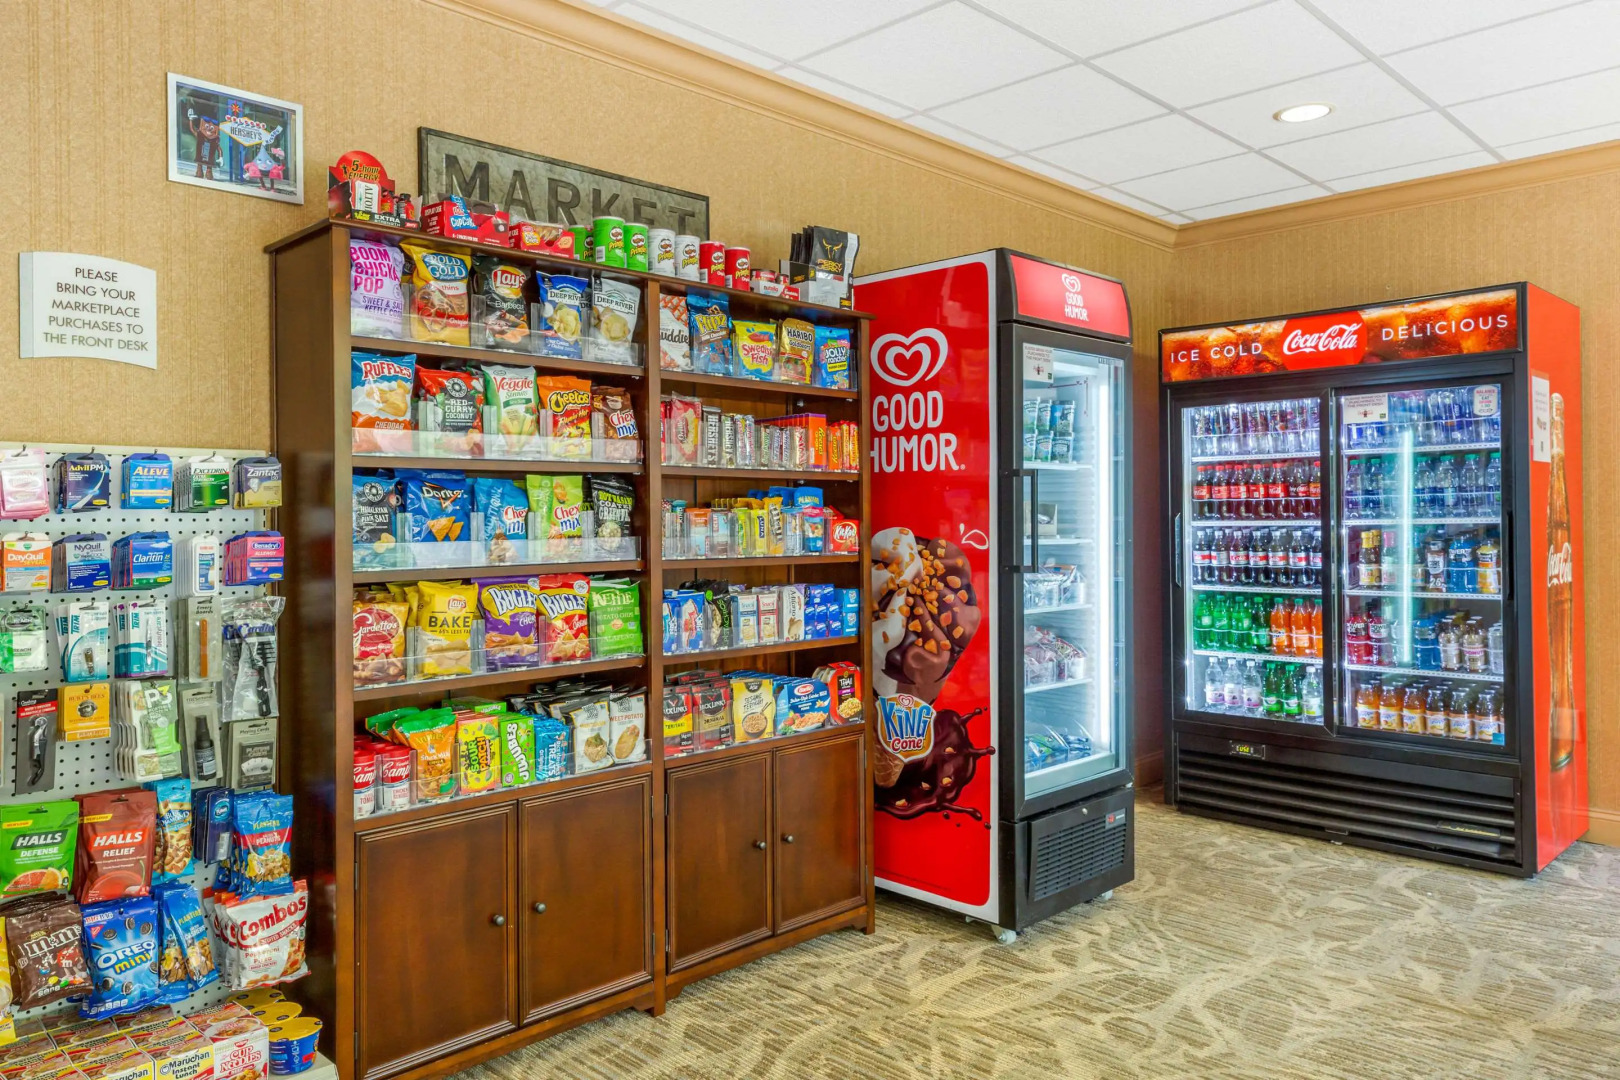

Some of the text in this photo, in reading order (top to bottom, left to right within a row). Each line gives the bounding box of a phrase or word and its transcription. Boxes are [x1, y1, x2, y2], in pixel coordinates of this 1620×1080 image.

[230, 126, 262, 141] HERSHEY'S
[365, 185, 374, 212] ALTOI
[444, 153, 695, 235] MARKET
[374, 214, 400, 224] EXTRA
[350, 246, 391, 263] BOOM
[75, 267, 118, 282] PLEASE
[427, 265, 465, 278] GOLD
[496, 271, 526, 288] Lay's
[56, 282, 136, 301] BRING YOUR
[353, 274, 384, 294] POP
[362, 295, 383, 306] SWEET
[549, 290, 565, 299] DEEP
[1065, 291, 1084, 307] GOOD
[52, 299, 140, 318] MARKETPLACE
[364, 305, 387, 315] KETTLE
[596, 297, 634, 312] DEEP RIVER
[1064, 304, 1089, 322] HUMOR
[48, 315, 144, 335] PURCHASES TO
[695, 313, 727, 334] Flipz
[1381, 314, 1509, 341] DELICIOUS
[43, 332, 149, 352] THE FRONT DESK
[787, 327, 813, 343] HARIBO
[1282, 322, 1363, 356] Coca-Cola
[751, 351, 769, 366] Fish
[825, 346, 847, 358] JOLLY
[1170, 342, 1263, 363] ICE COLD
[362, 360, 412, 380] RUFFLES
[493, 376, 533, 393] Veggie
[550, 391, 590, 412] Cheetos
[609, 411, 634, 426] Chex
[872, 390, 944, 432] GOOD
[374, 421, 404, 430] CHEDDAR
[617, 422, 637, 437] mix
[707, 415, 719, 461] HERSHEY'S
[870, 433, 958, 473] HUMOR
[69, 464, 90, 472] Advil
[133, 466, 170, 475] ALEVE
[247, 468, 280, 477] Zantac
[375, 514, 389, 522] SALT
[553, 504, 580, 520] Chex
[507, 519, 526, 534] mi
[560, 518, 581, 532] mix
[757, 515, 765, 538] LUNA
[74, 542, 102, 552] NyQuil
[8, 552, 44, 562] DayQuil
[133, 553, 163, 563] Claritin
[71, 614, 80, 635] TRIM
[131, 612, 140, 629] TRIM
[428, 615, 471, 628] BAKE
[879, 697, 932, 743] KING
[506, 722, 531, 781] JUJUBES
[890, 737, 924, 752] Cone
[467, 739, 480, 773] SOUR
[475, 736, 489, 773] PATCH
[548, 742, 556, 776] TREATS
[252, 820, 280, 830] PLANTERS
[16, 832, 63, 847] HALLS
[93, 831, 144, 847] HALLS
[20, 846, 59, 857] DEFENSE
[103, 847, 136, 858] RELIEF
[99, 912, 114, 921] BAG
[238, 895, 307, 941] Combos
[97, 940, 155, 969] OREO
[114, 950, 151, 974] mini
[169, 1050, 210, 1069] Maruchan
[230, 1046, 254, 1060] CUP
[172, 1062, 201, 1076] Instant
[220, 1051, 262, 1072] NOODLES
[175, 1068, 198, 1080] Lunch
